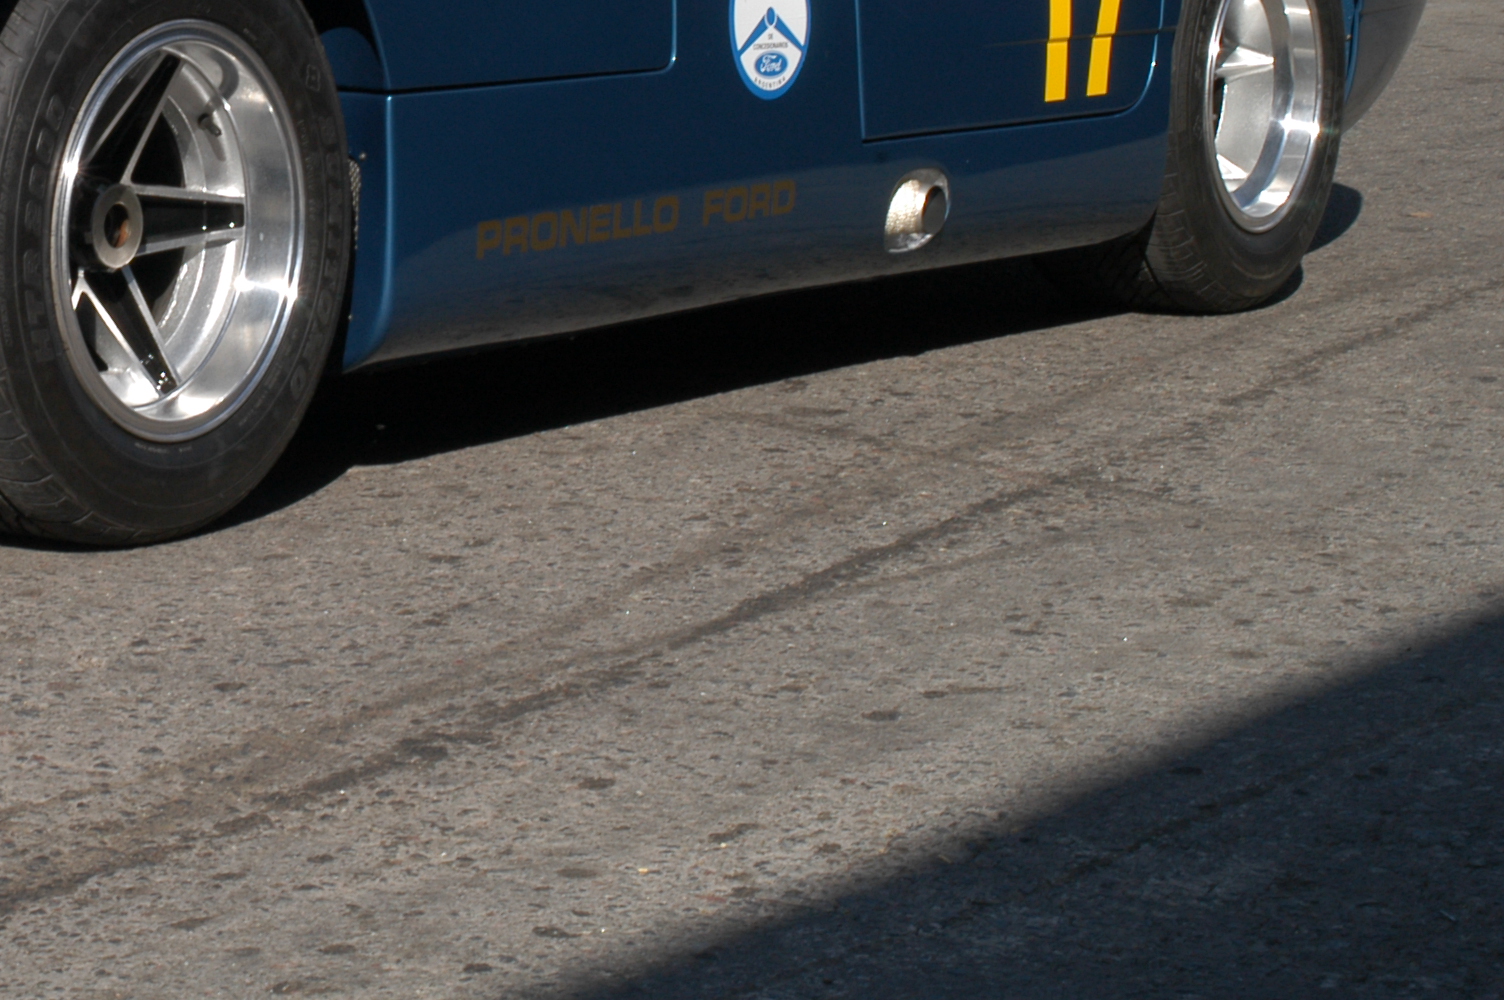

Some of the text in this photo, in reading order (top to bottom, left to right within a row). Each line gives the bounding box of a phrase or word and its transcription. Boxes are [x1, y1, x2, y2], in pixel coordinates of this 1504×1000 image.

[760, 54, 783, 72] Ford
[476, 178, 796, 260] PRONELLO FORD
